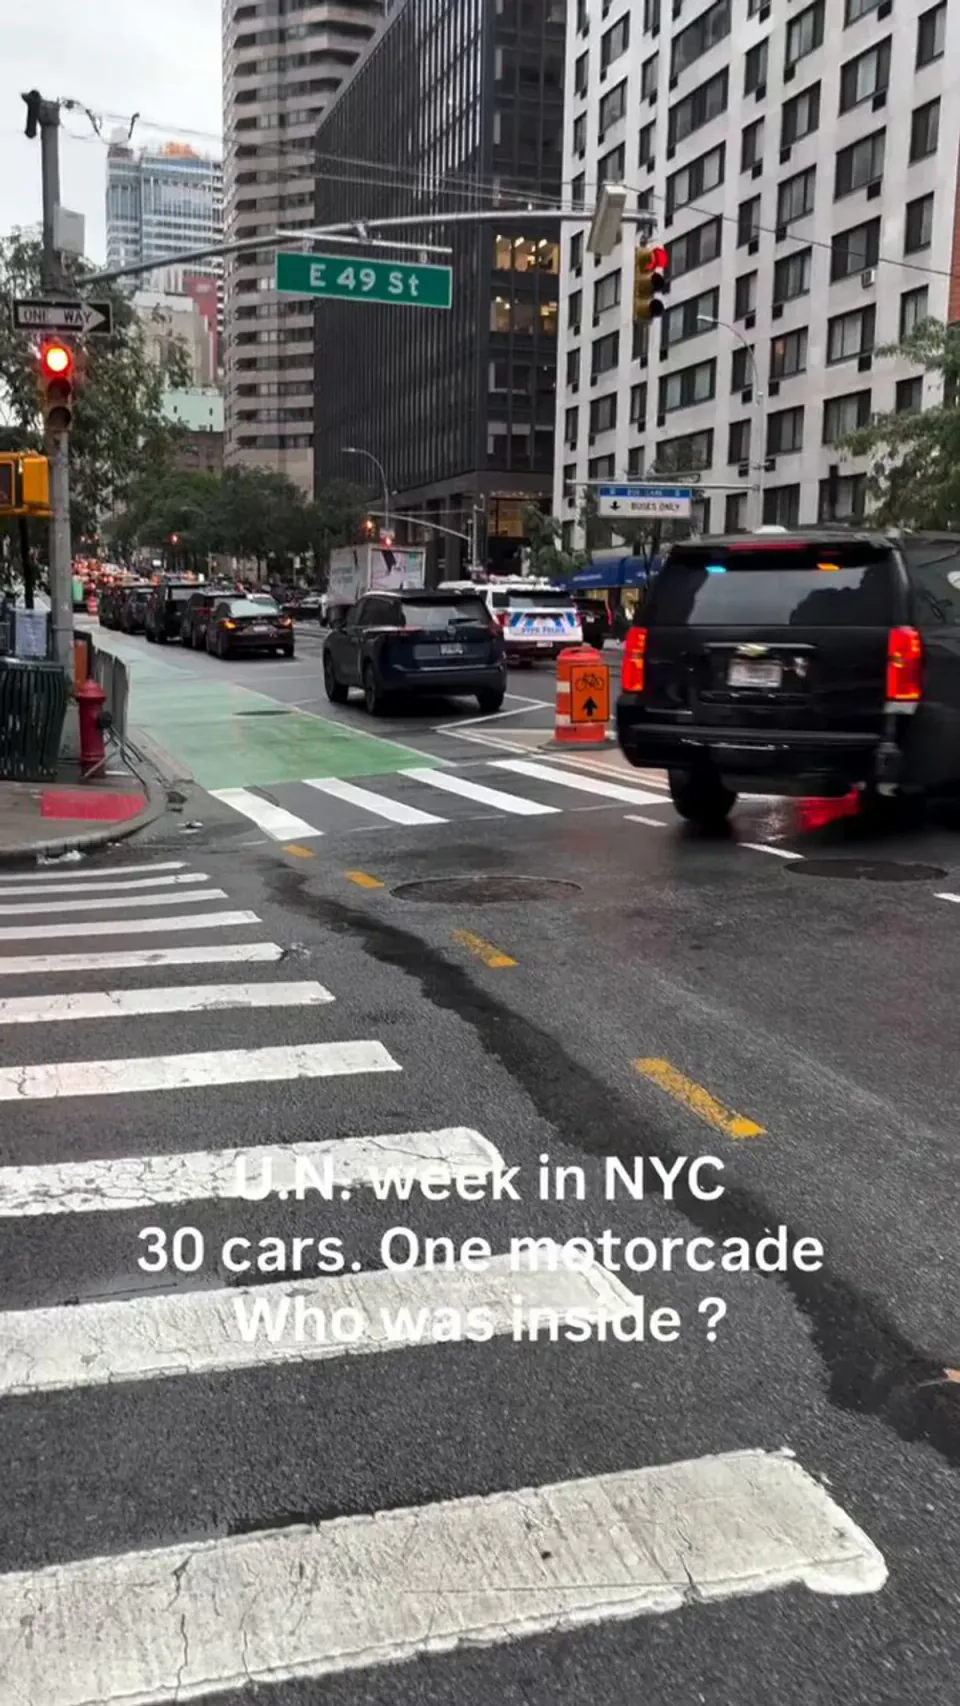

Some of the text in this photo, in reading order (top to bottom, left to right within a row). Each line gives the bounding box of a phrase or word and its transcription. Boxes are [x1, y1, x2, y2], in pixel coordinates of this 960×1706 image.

[310, 263, 420, 297] E 49 St
[63, 308, 93, 324] WAY
